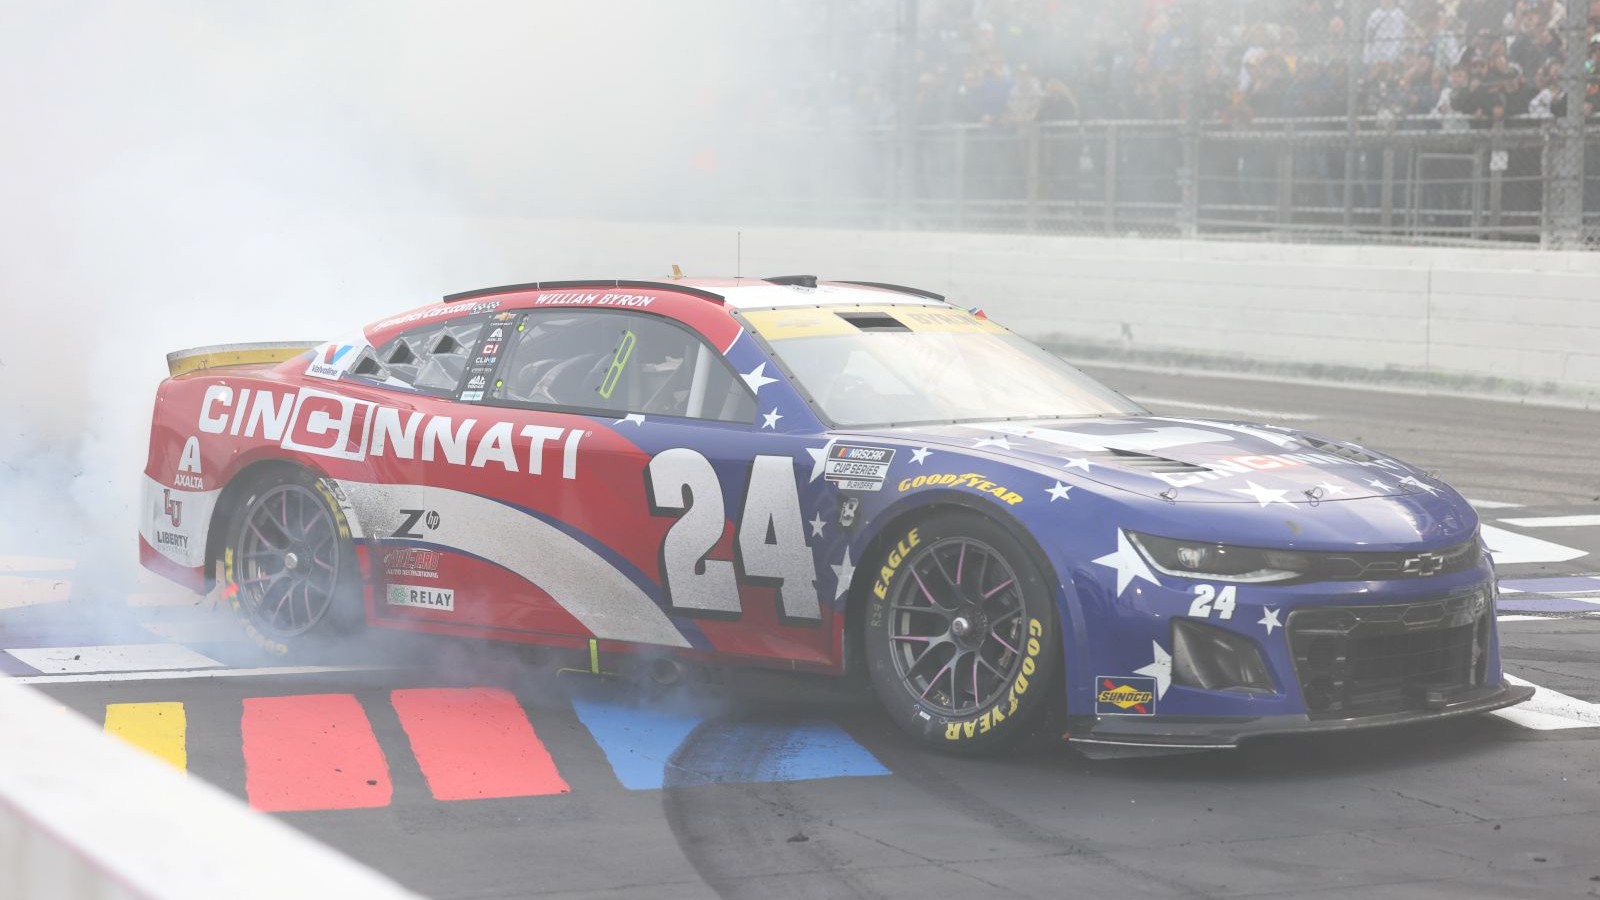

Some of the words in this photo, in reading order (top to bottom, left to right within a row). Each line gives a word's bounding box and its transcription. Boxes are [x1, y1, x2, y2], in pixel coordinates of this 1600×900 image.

[535, 293, 600, 305] WILLIAM
[597, 294, 657, 307] BYRON
[482, 345, 499, 354] CI
[311, 364, 339, 377] Valvoline
[198, 384, 585, 480] CINCINNATI
[848, 449, 886, 461] NASCAR
[833, 463, 851, 474] CUP
[851, 464, 880, 476] SERIES
[174, 473, 204, 490] AXALTA
[846, 481, 874, 490] PLAYOFFS
[898, 473, 1024, 506] GOODYEAR
[391, 509, 425, 539] Z
[427, 511, 440, 531] hp
[156, 531, 188, 548] LIBERTY
[645, 447, 823, 622] 24
[873, 528, 921, 600] EAGLE
[410, 589, 452, 607] RELAY
[1188, 584, 1237, 620] 24
[945, 618, 1043, 740] GOODYEAR
[1100, 691, 1152, 703] SUNOCO
